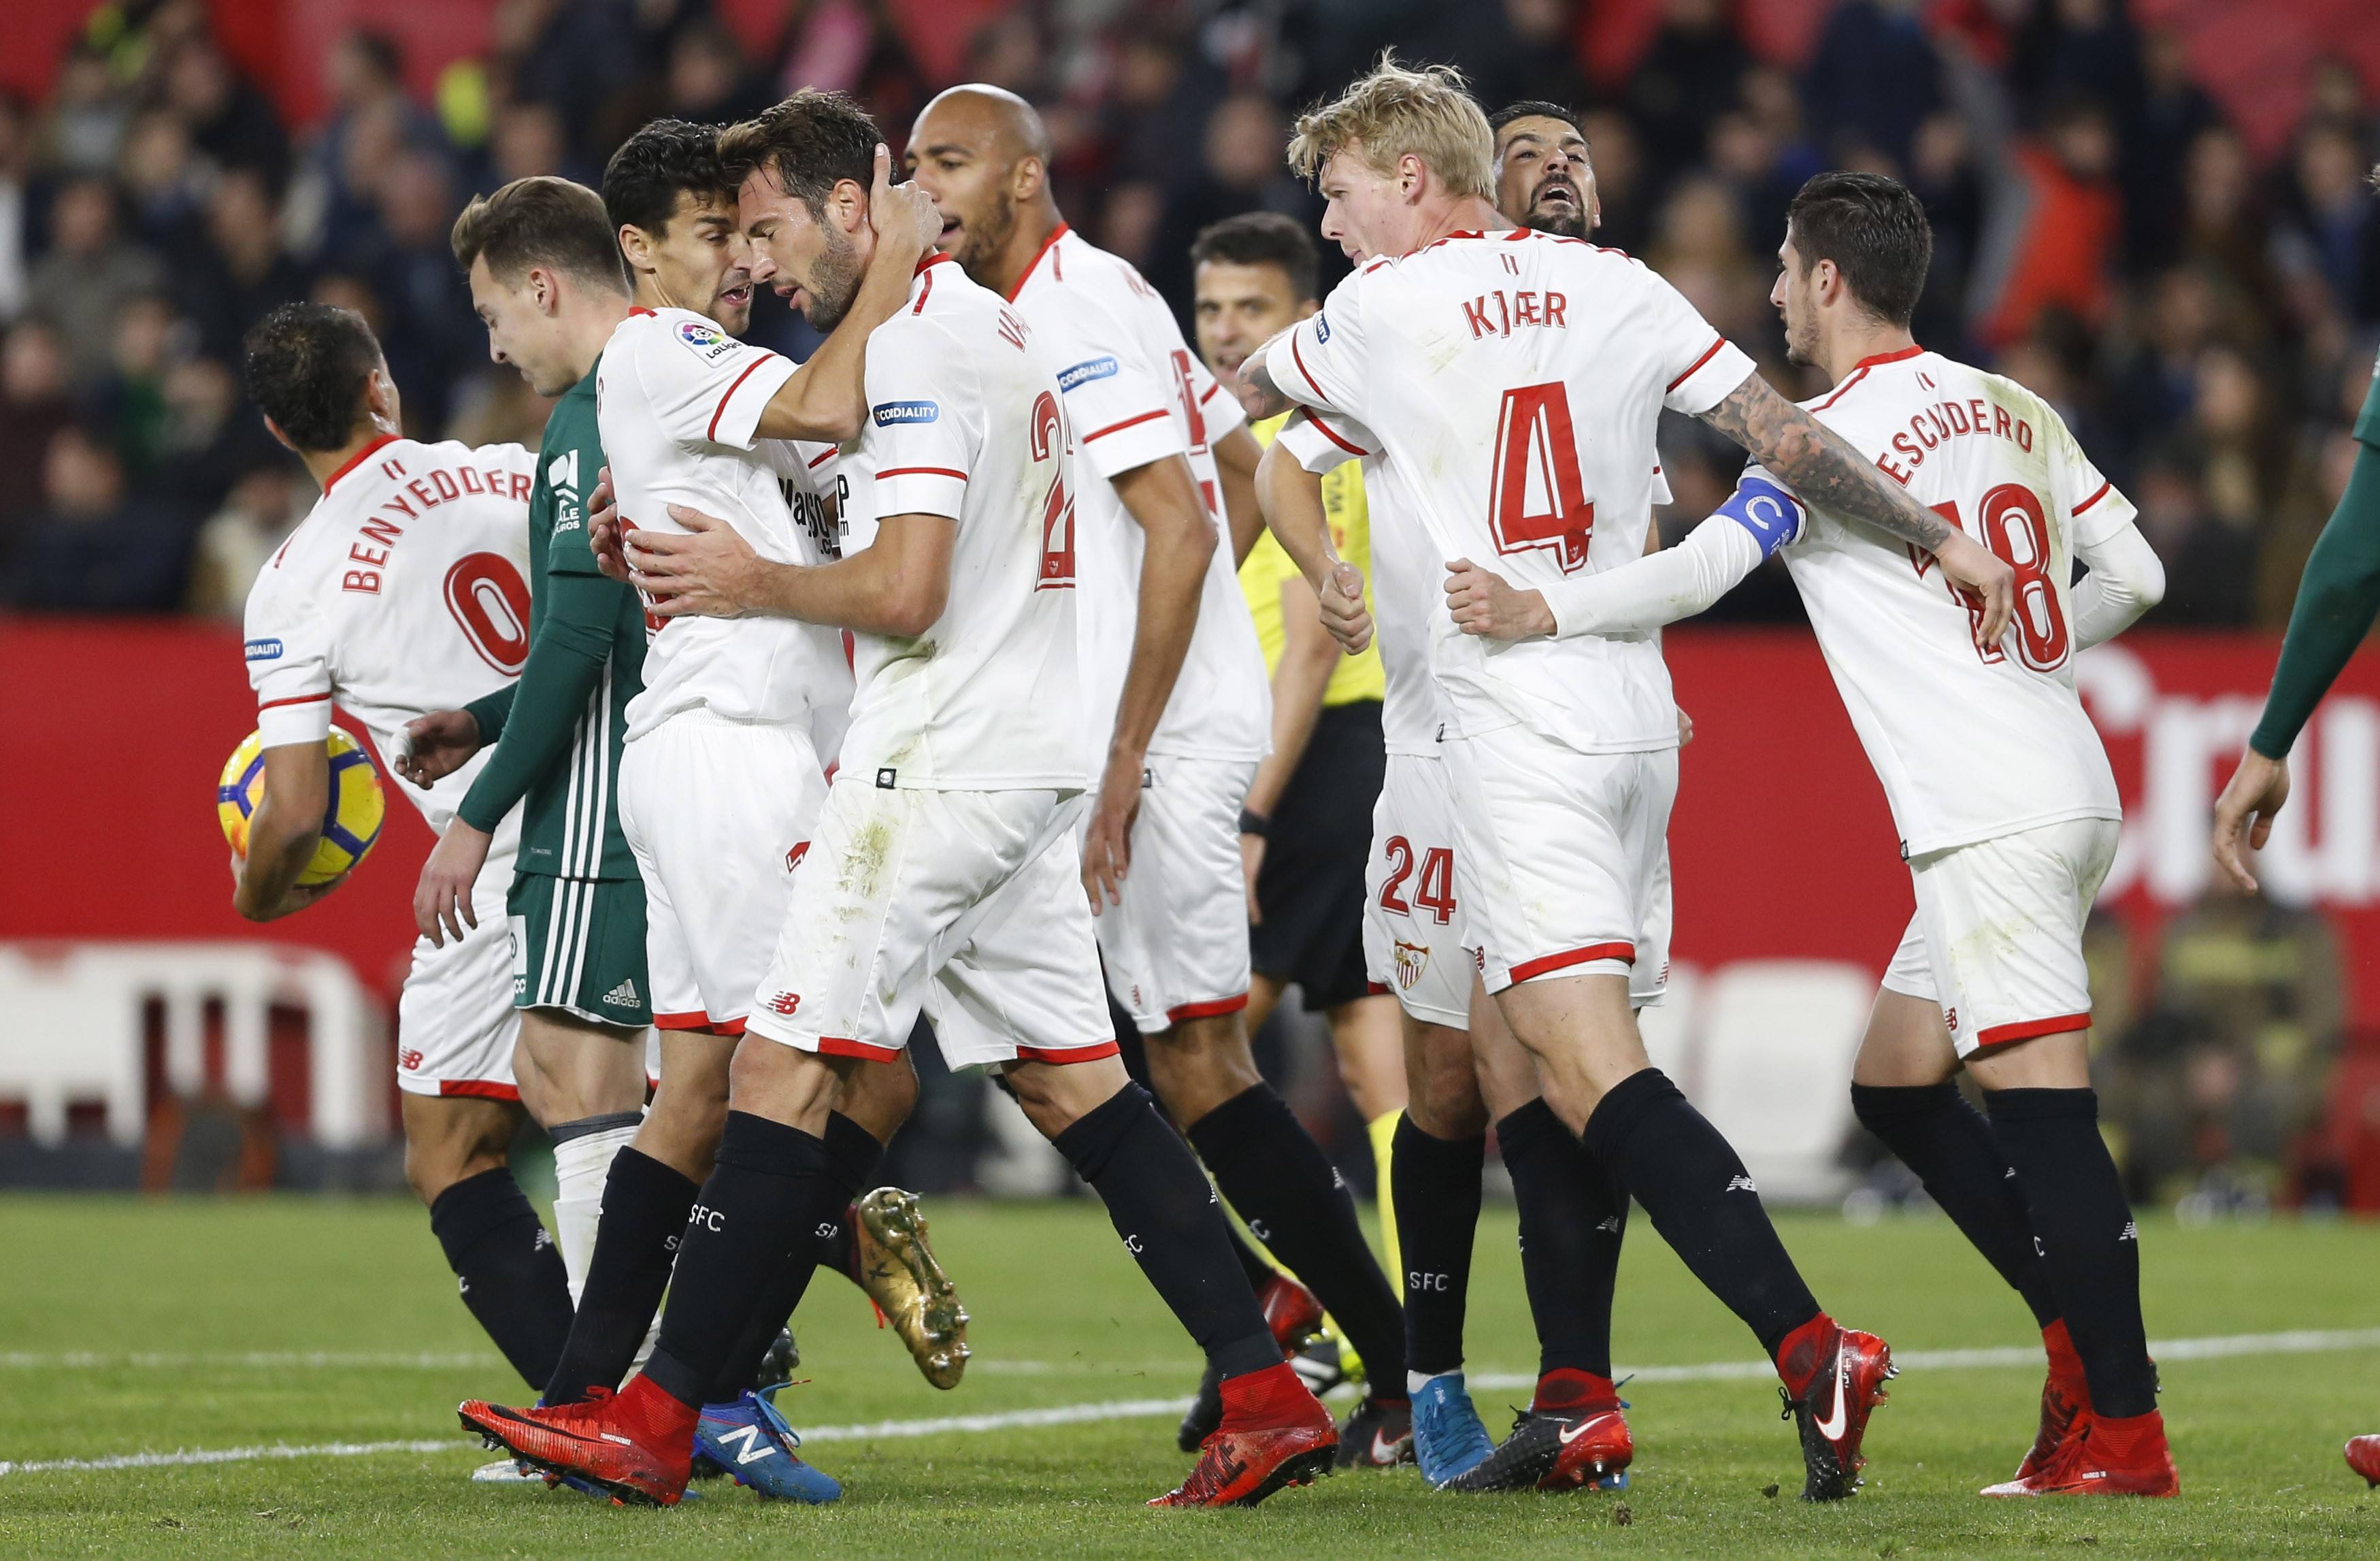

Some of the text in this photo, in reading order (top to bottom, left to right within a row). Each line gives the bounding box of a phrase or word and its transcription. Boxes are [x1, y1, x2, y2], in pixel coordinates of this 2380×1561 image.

[706, 342, 742, 359] LaLiga
[879, 407, 936, 421] CORDIALITY
[1875, 398, 2033, 487] ESCUDERO
[1488, 380, 1593, 576] 4
[1745, 495, 1783, 530] C
[342, 465, 531, 595] BEN YEDDER
[1378, 834, 1457, 925] 24
[603, 994, 640, 1008] adidas
[689, 1204, 725, 1233] SFC
[1410, 1272, 1448, 1292] SFC
